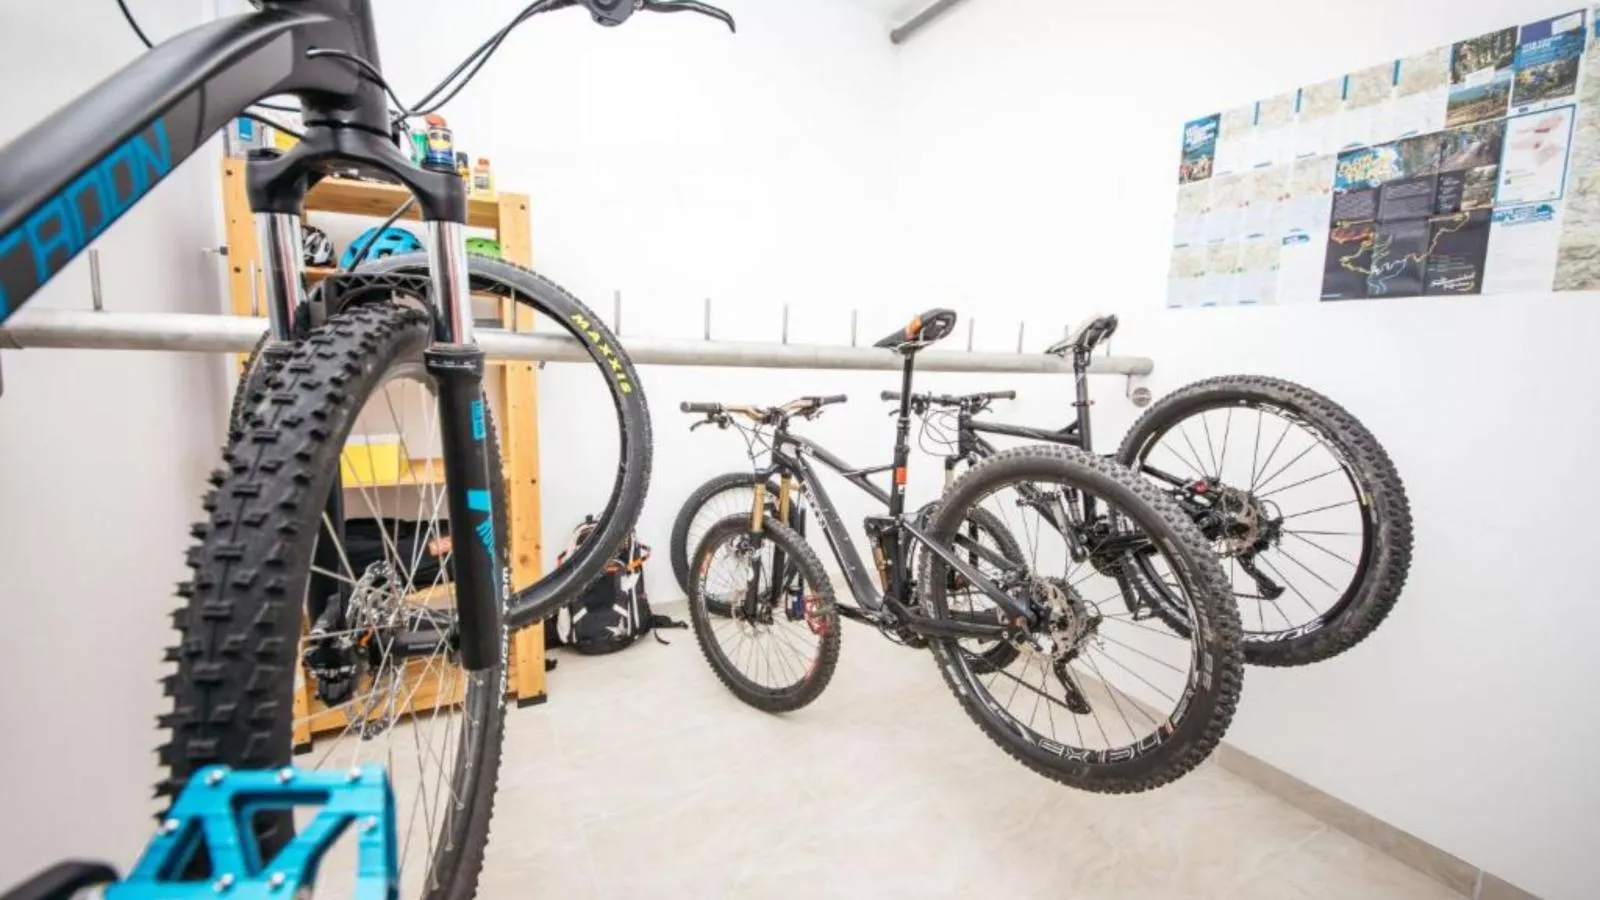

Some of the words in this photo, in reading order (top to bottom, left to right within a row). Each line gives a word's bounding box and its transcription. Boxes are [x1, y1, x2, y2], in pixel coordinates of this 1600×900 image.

[571, 313, 632, 394] MAXXIS
[501, 567, 510, 614] TOM
[497, 624, 510, 710] TOUGH
